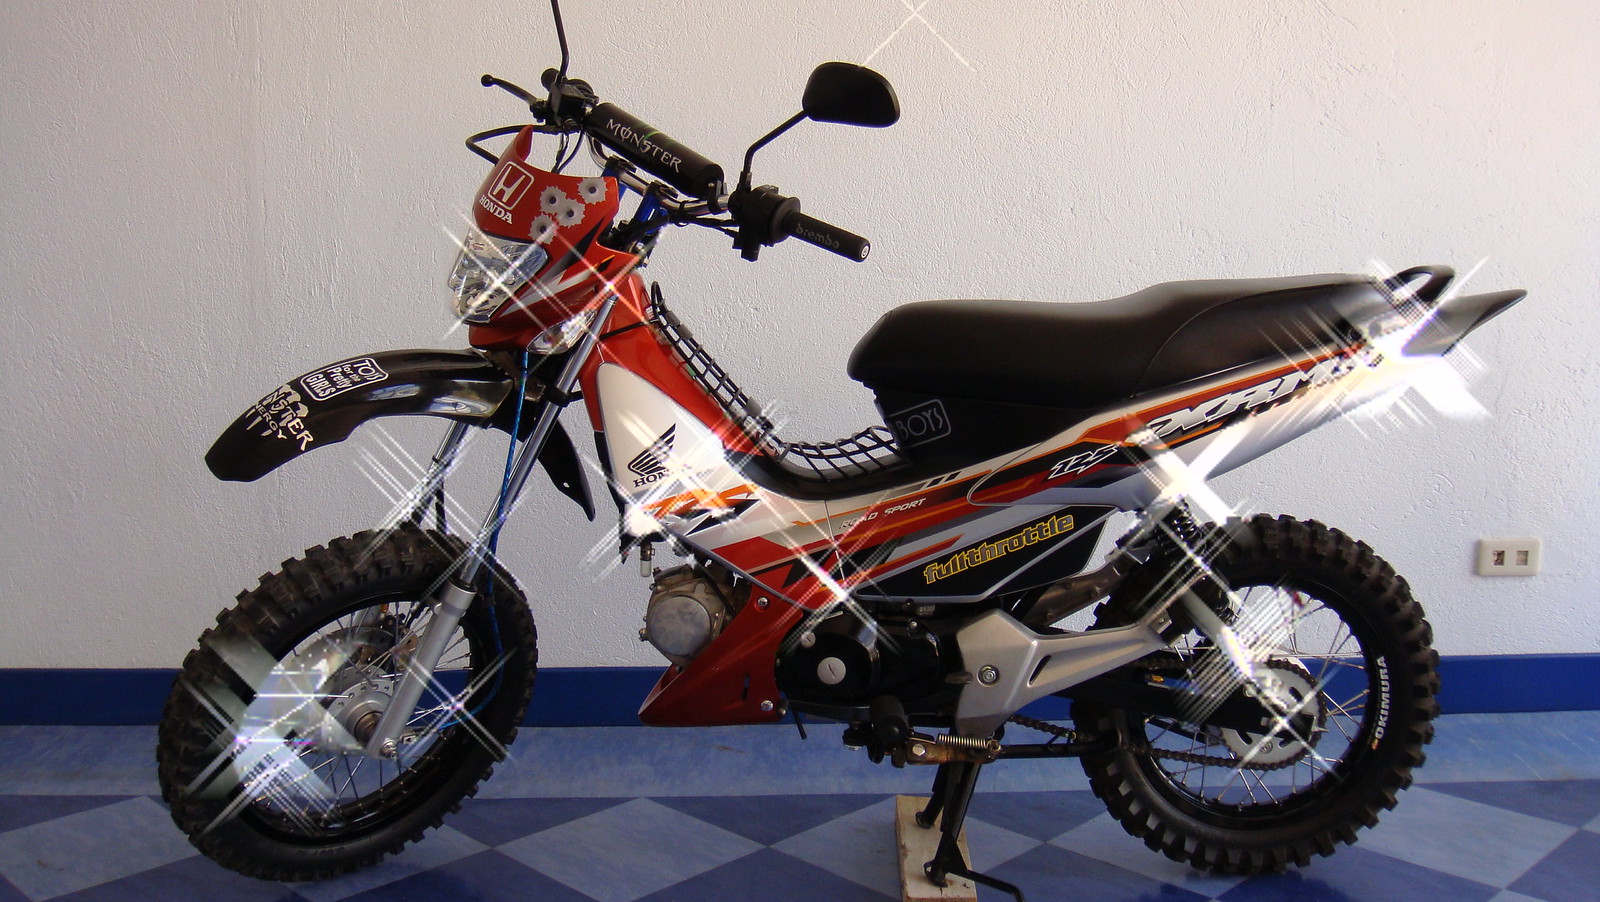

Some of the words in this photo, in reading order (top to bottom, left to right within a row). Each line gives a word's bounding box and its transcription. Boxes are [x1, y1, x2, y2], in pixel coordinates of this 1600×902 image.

[478, 194, 513, 225] HONDA
[796, 223, 840, 249] brembo
[305, 373, 336, 397] GIRLS
[255, 402, 288, 440] NERGY
[266, 390, 314, 451] NSTER
[895, 407, 943, 441] BOYS
[884, 497, 926, 515] SPORT
[1374, 655, 1391, 740] OKIMURA
